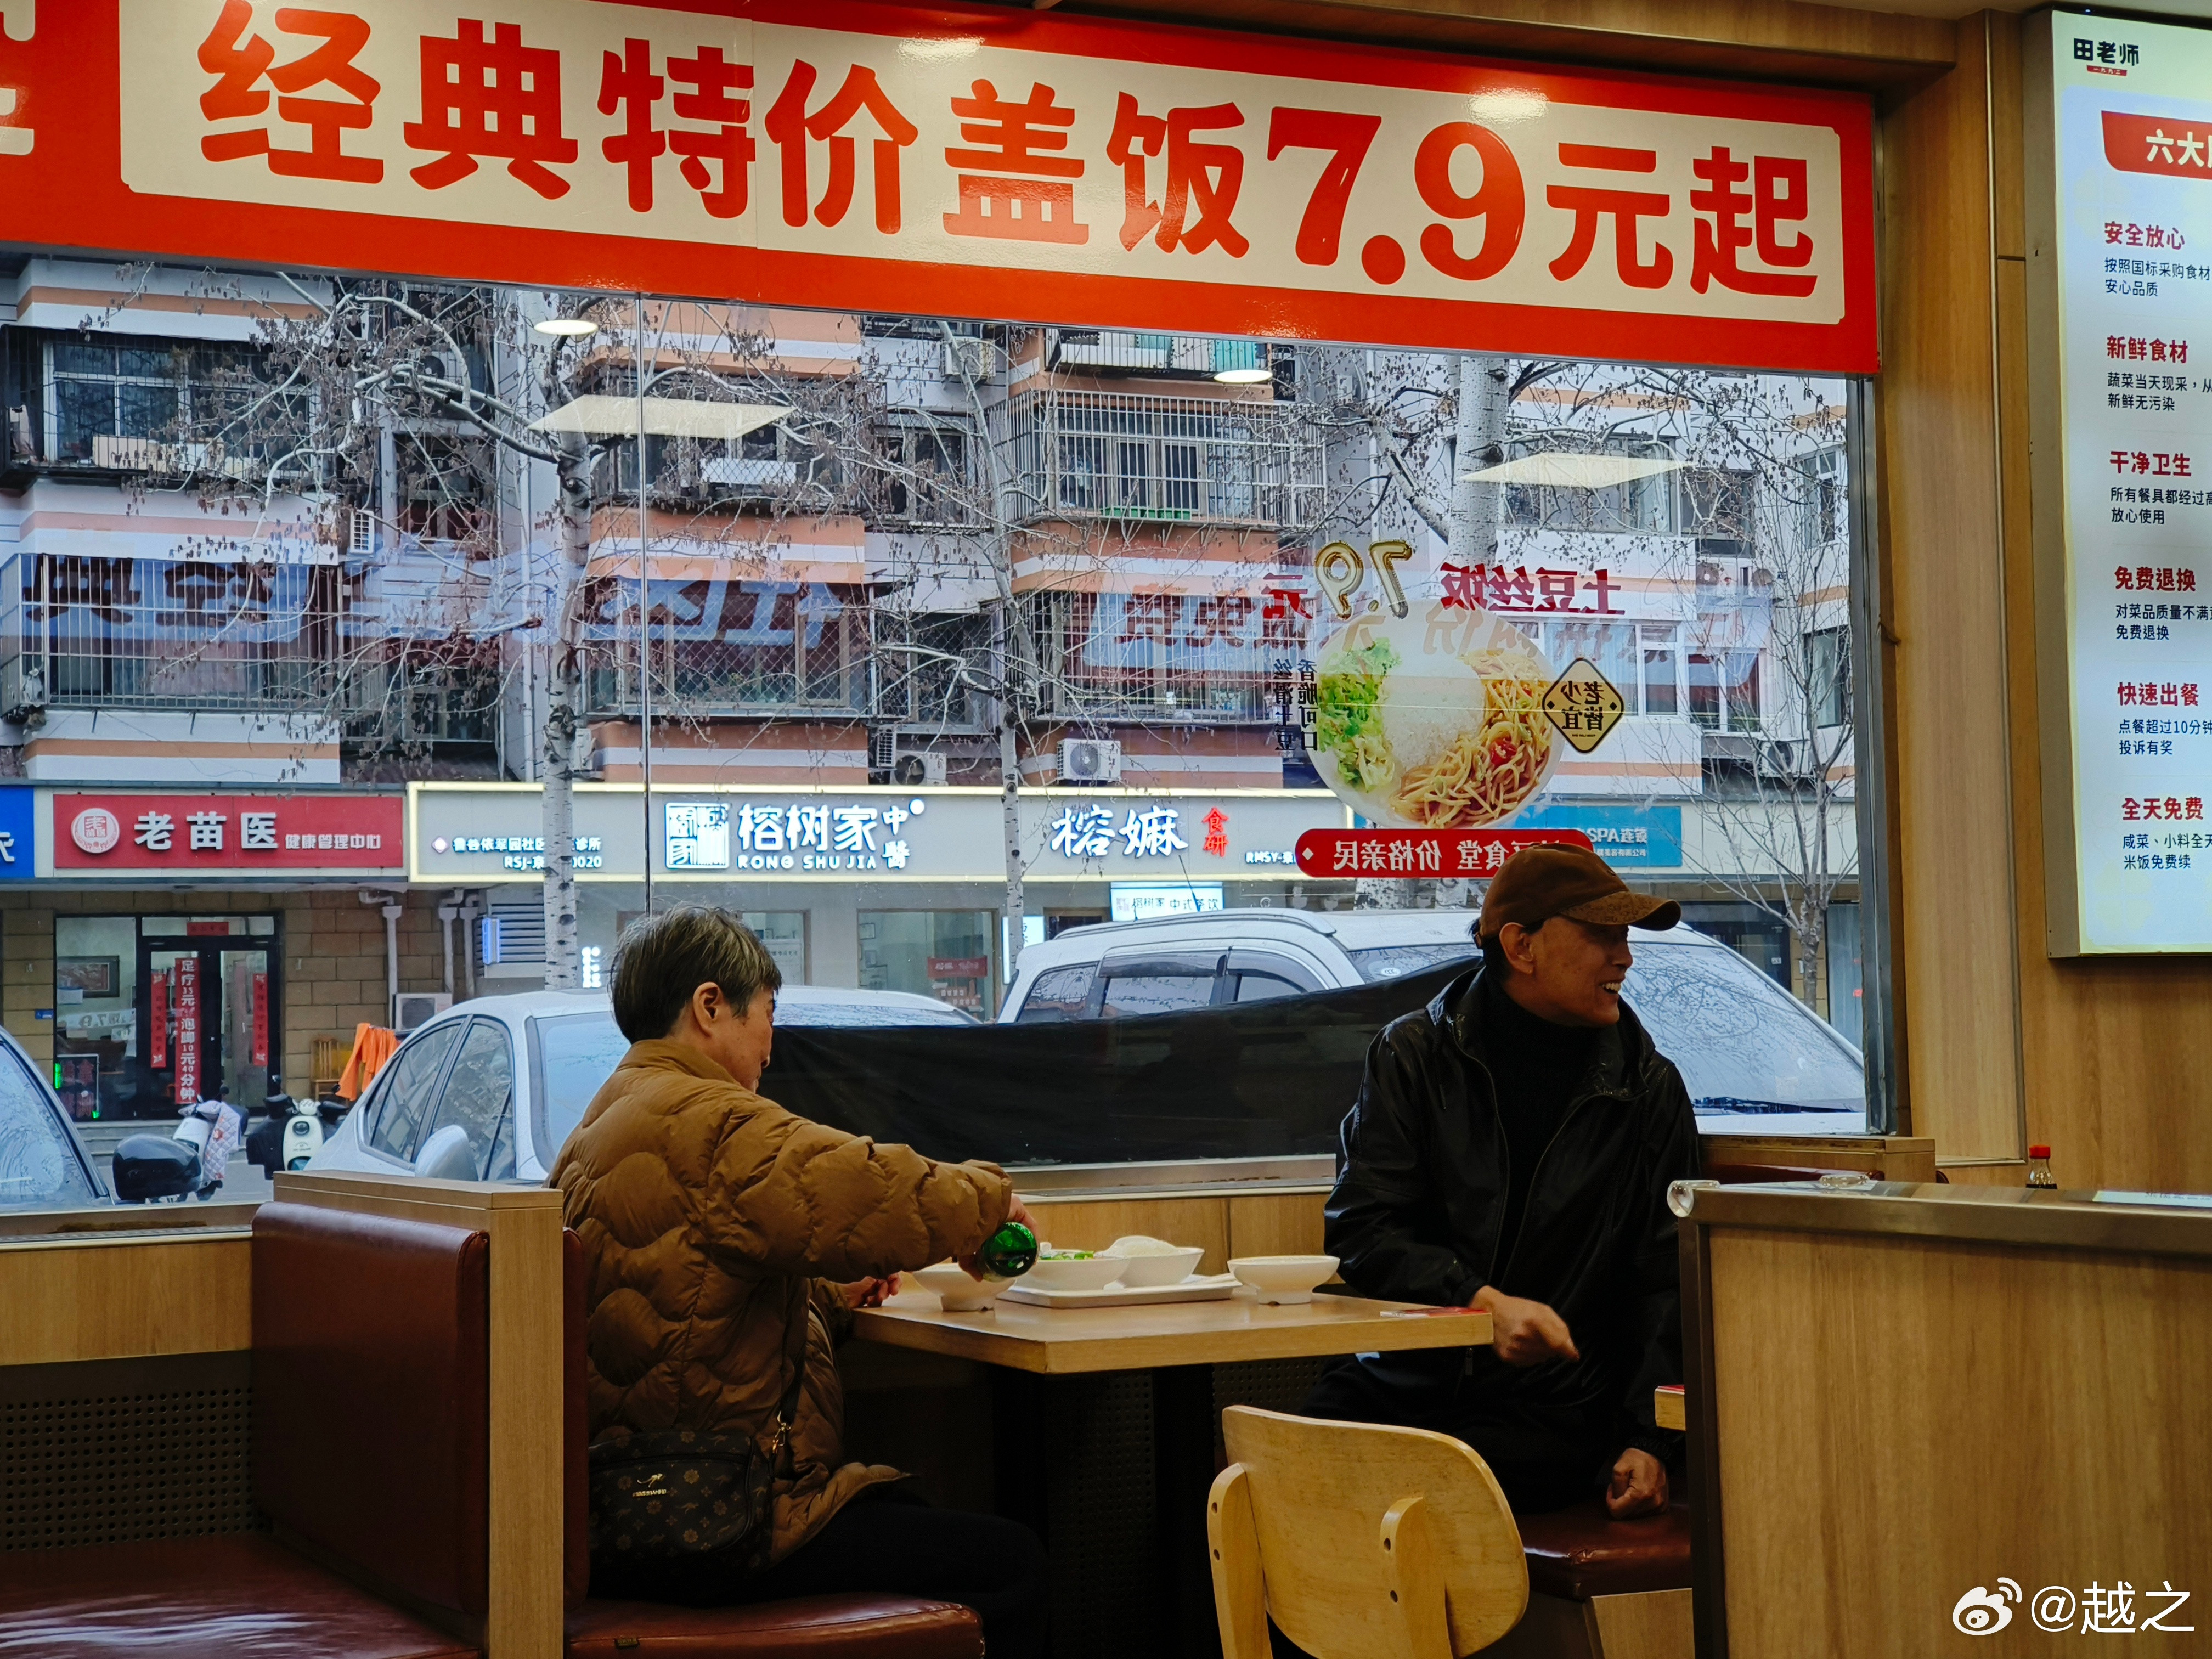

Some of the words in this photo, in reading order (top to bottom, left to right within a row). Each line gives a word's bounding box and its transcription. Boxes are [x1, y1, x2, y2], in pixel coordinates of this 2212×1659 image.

[2074, 38, 2139, 66] 田老师
[198, 0, 1818, 298] 经典特价盖饭7.9元起
[2146, 128, 2212, 168] 六大
[2104, 221, 2185, 250] 安全放心
[2104, 257, 2211, 281] 按照国标采购食材
[2105, 279, 2158, 297] 安心品质
[2107, 335, 2188, 364] 新鲜食材
[2108, 393, 2175, 411] 新鲜无污染
[2109, 450, 2192, 477] 干净卫生
[2112, 508, 2165, 524] 放心使用
[2114, 566, 2196, 591] 免费退换
[2115, 603, 2212, 620] 对菜品质量不满
[2116, 624, 2169, 640] 免费退换
[2118, 682, 2199, 707] 快速出餐
[2119, 719, 2212, 735] 点餐超过10分钟
[2119, 740, 2173, 755] 投诉有奖
[2121, 797, 2203, 821] 全天免费
[134, 811, 279, 850] 老苗医
[285, 833, 382, 849] 健康管理中心
[737, 804, 878, 851] 榕树家
[802, 855, 840, 870] SHU
[845, 855, 877, 870] JIA
[2124, 854, 2191, 870] 米饭免费续
